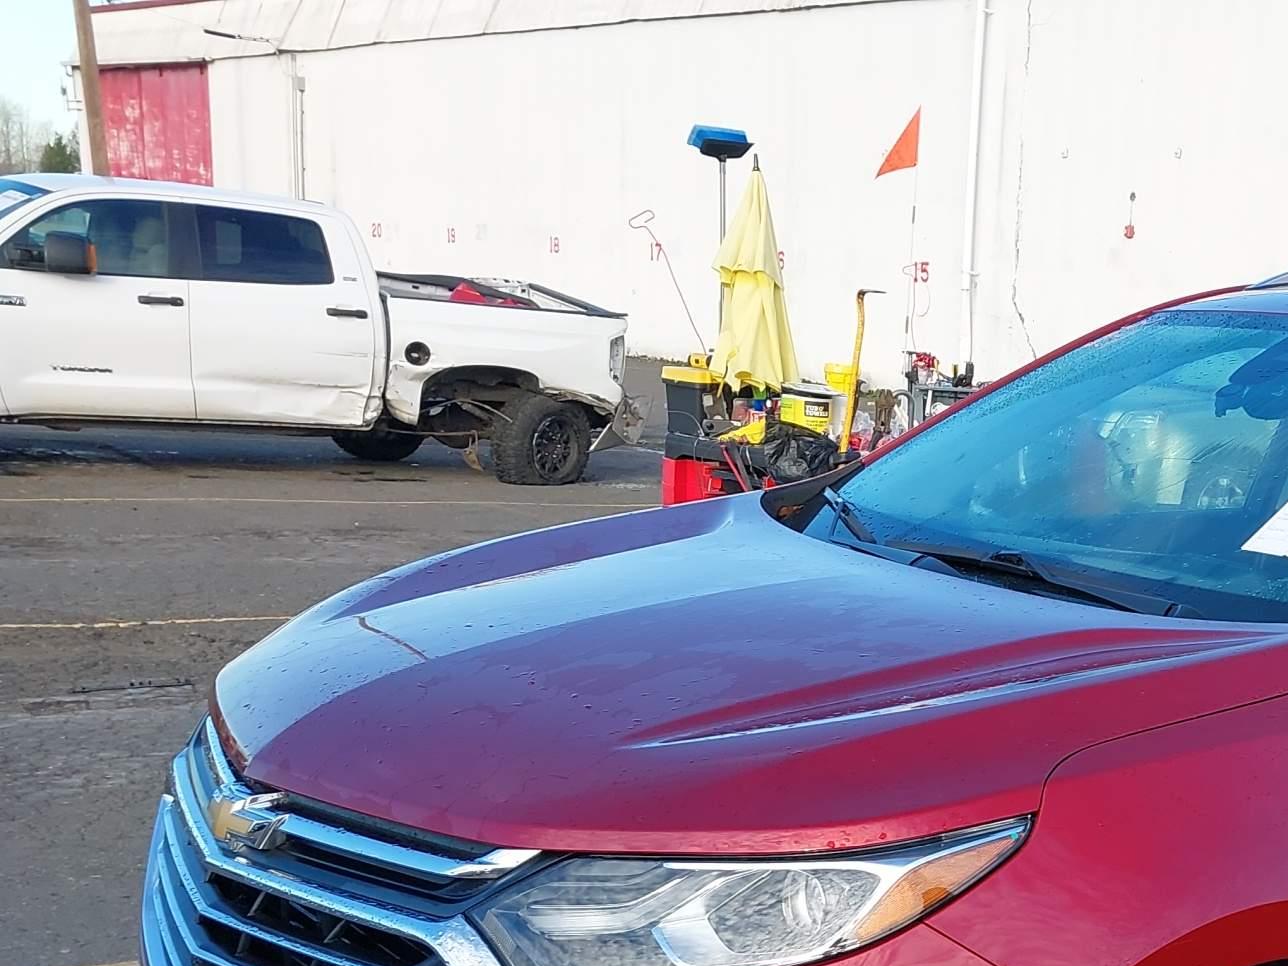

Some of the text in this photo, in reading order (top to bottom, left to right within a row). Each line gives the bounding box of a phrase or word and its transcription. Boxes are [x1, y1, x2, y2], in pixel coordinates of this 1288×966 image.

[371, 223, 382, 239] 20
[447, 228, 456, 243] 19
[549, 236, 560, 253] 18
[650, 242, 663, 261] 17
[913, 262, 930, 283] 15
